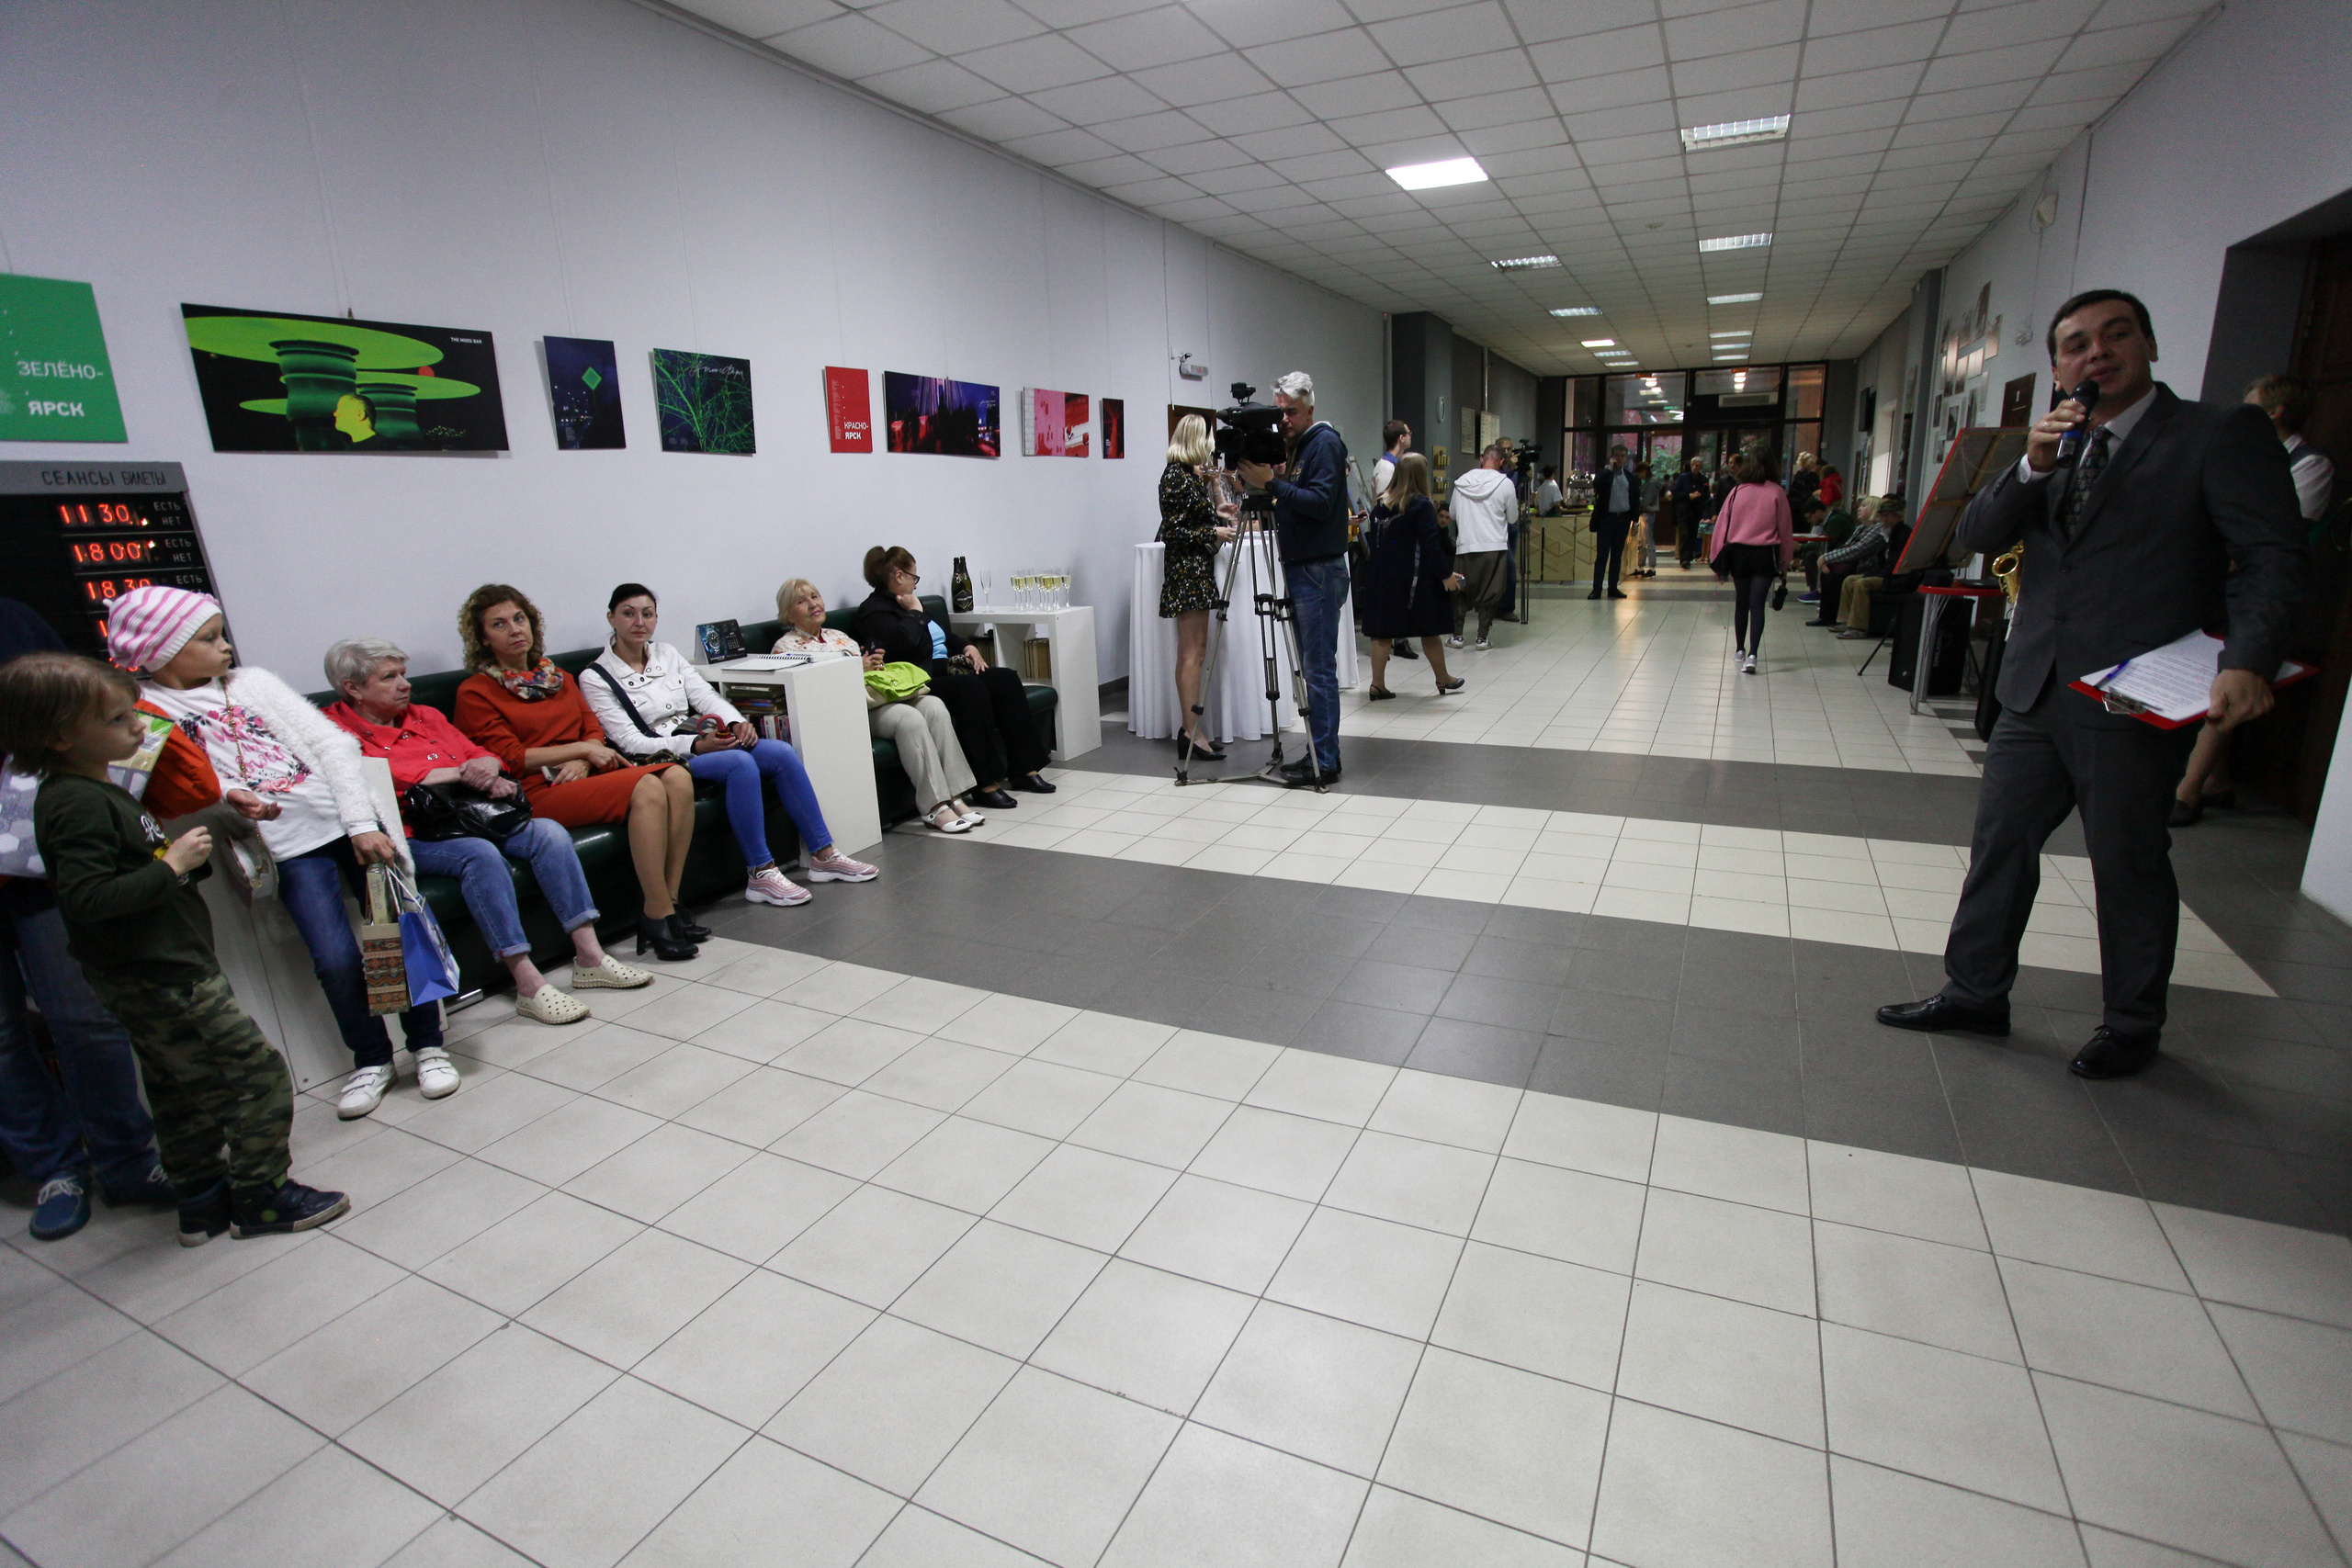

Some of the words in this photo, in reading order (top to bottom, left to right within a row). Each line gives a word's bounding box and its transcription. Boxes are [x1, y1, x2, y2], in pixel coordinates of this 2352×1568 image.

[17, 359, 104, 379] ЗЕЛЁНО-
[28, 400, 85, 417] ЯРСК
[843, 422, 869, 430] КРАСНО-
[844, 432, 862, 440] ЯРСК
[41, 470, 115, 486] СЕАНСЫ
[121, 470, 166, 486] БИЛЕТЫ
[153, 501, 181, 511] ЕСТЬ
[161, 515, 182, 525] НЕТ
[164, 538, 192, 548] ЕСТЬ
[173, 553, 192, 563] НЕТ
[175, 574, 202, 584] ЕСТЬ
